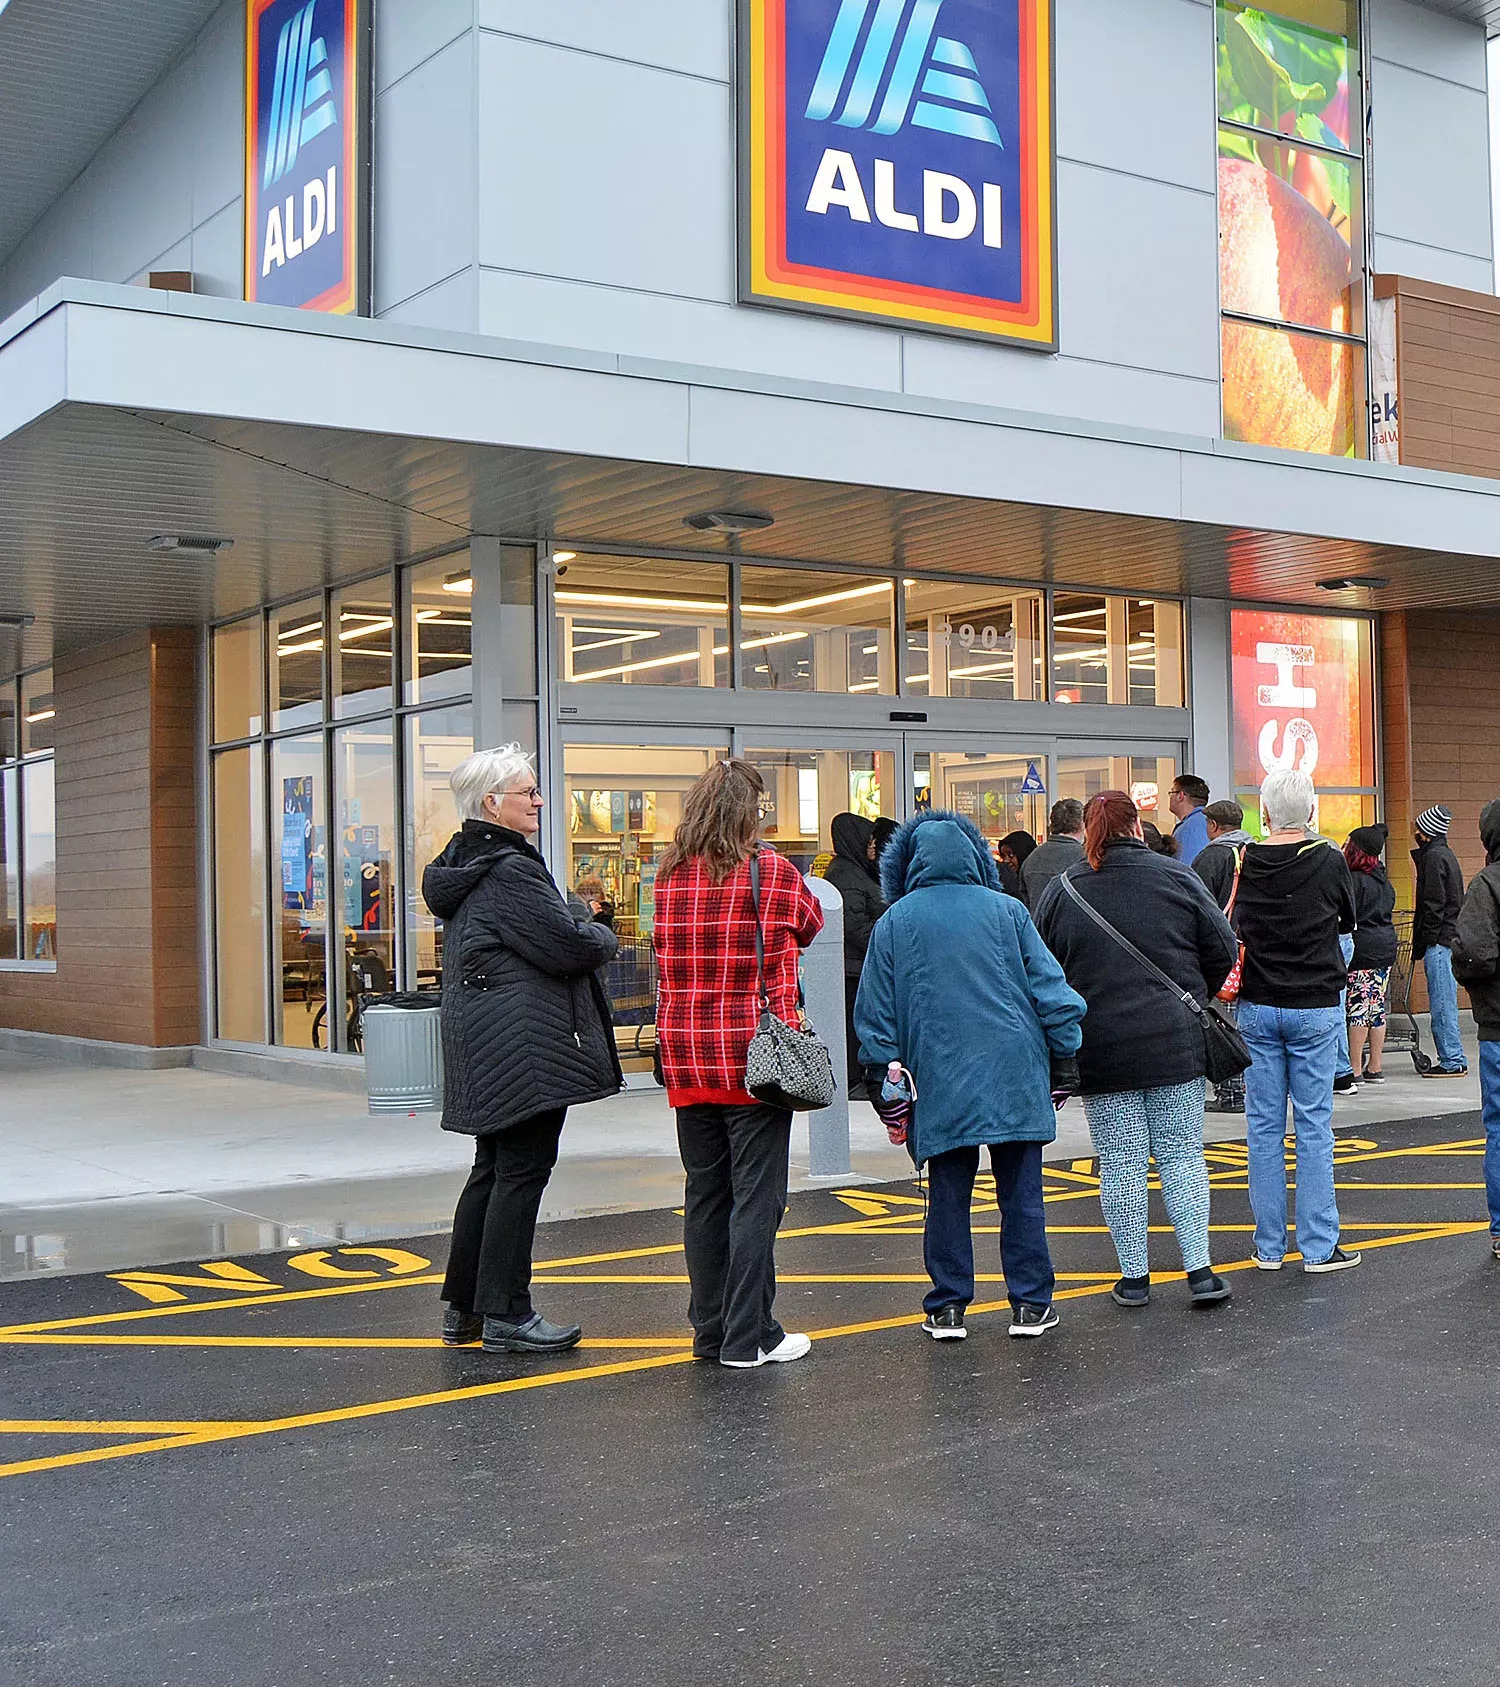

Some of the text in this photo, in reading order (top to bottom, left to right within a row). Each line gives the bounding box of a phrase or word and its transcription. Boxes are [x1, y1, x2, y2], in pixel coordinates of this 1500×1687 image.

[262, 165, 337, 278] ALDI
[804, 147, 1003, 249] ALDI
[936, 623, 1017, 650] 2901
[1256, 641, 1319, 838] SH
[106, 1247, 432, 1303] NO
